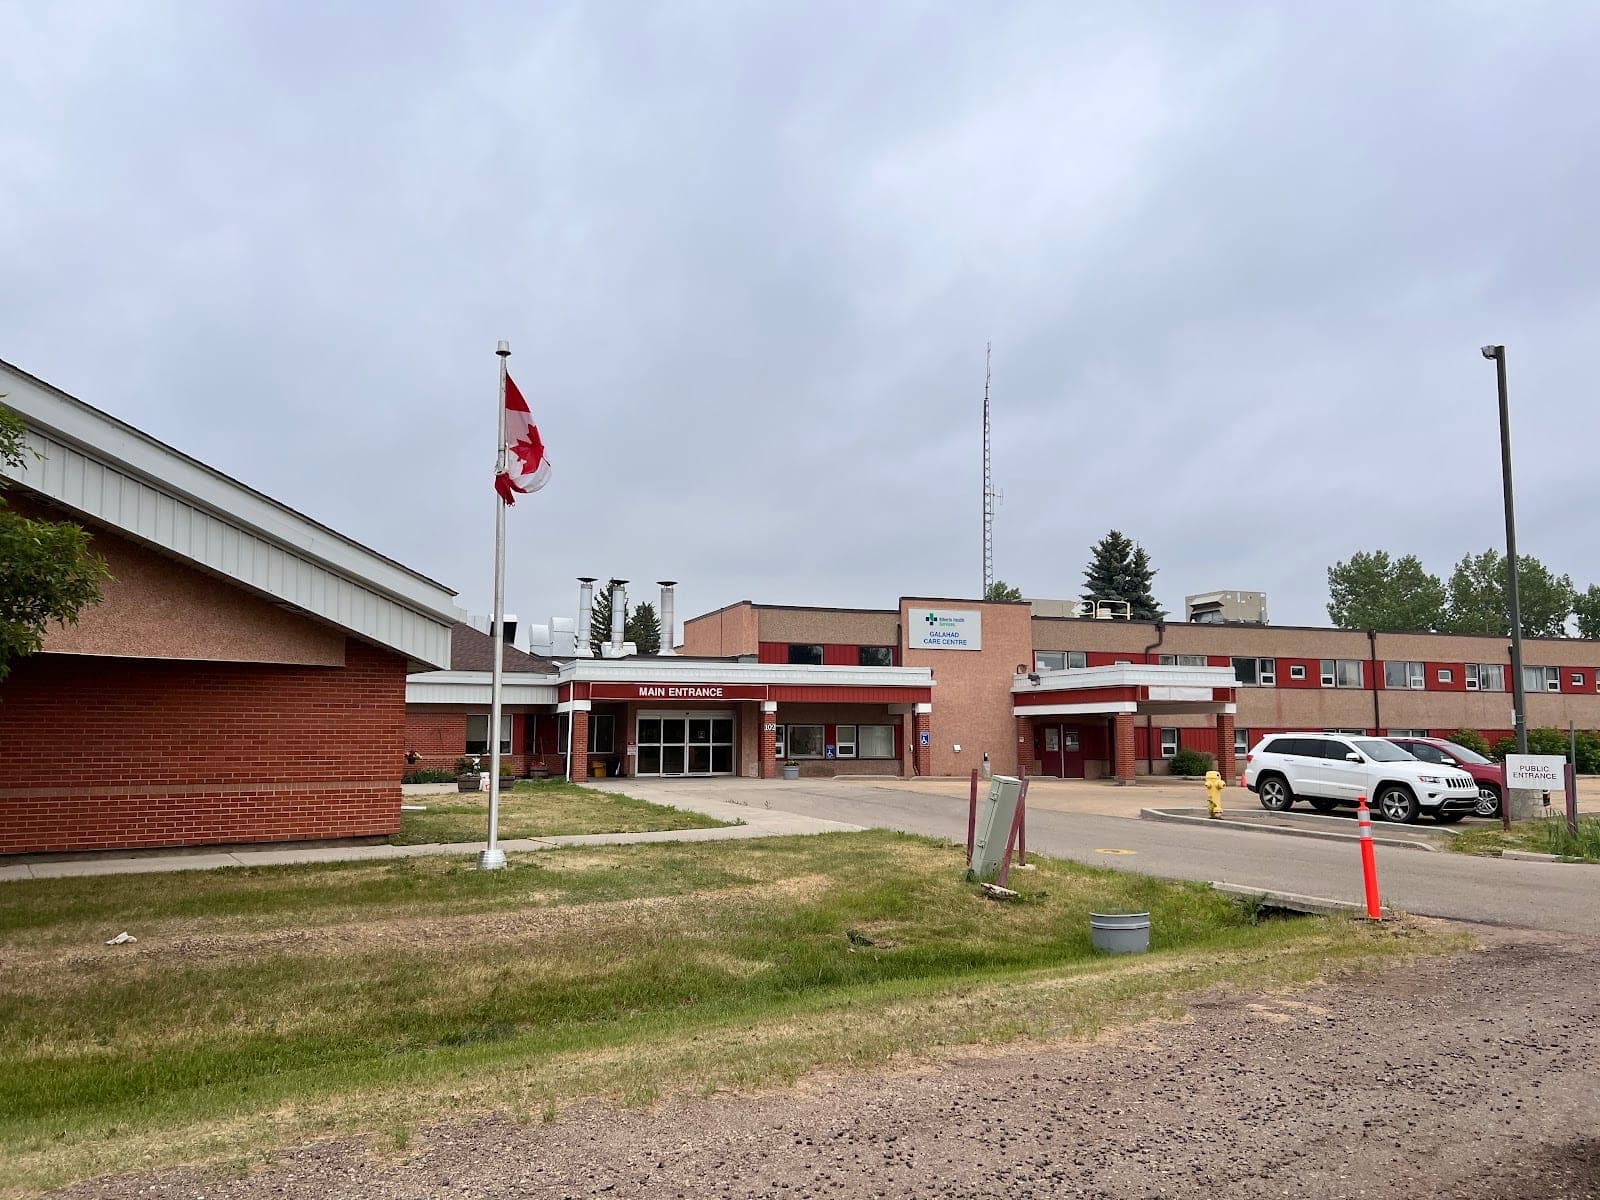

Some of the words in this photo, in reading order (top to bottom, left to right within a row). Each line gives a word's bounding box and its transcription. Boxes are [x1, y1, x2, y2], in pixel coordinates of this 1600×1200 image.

[639, 687, 665, 697] MAIN
[668, 687, 723, 697] ENTRANCE
[764, 723, 776, 731] 102
[1512, 771, 1557, 780] ENTRANCE
